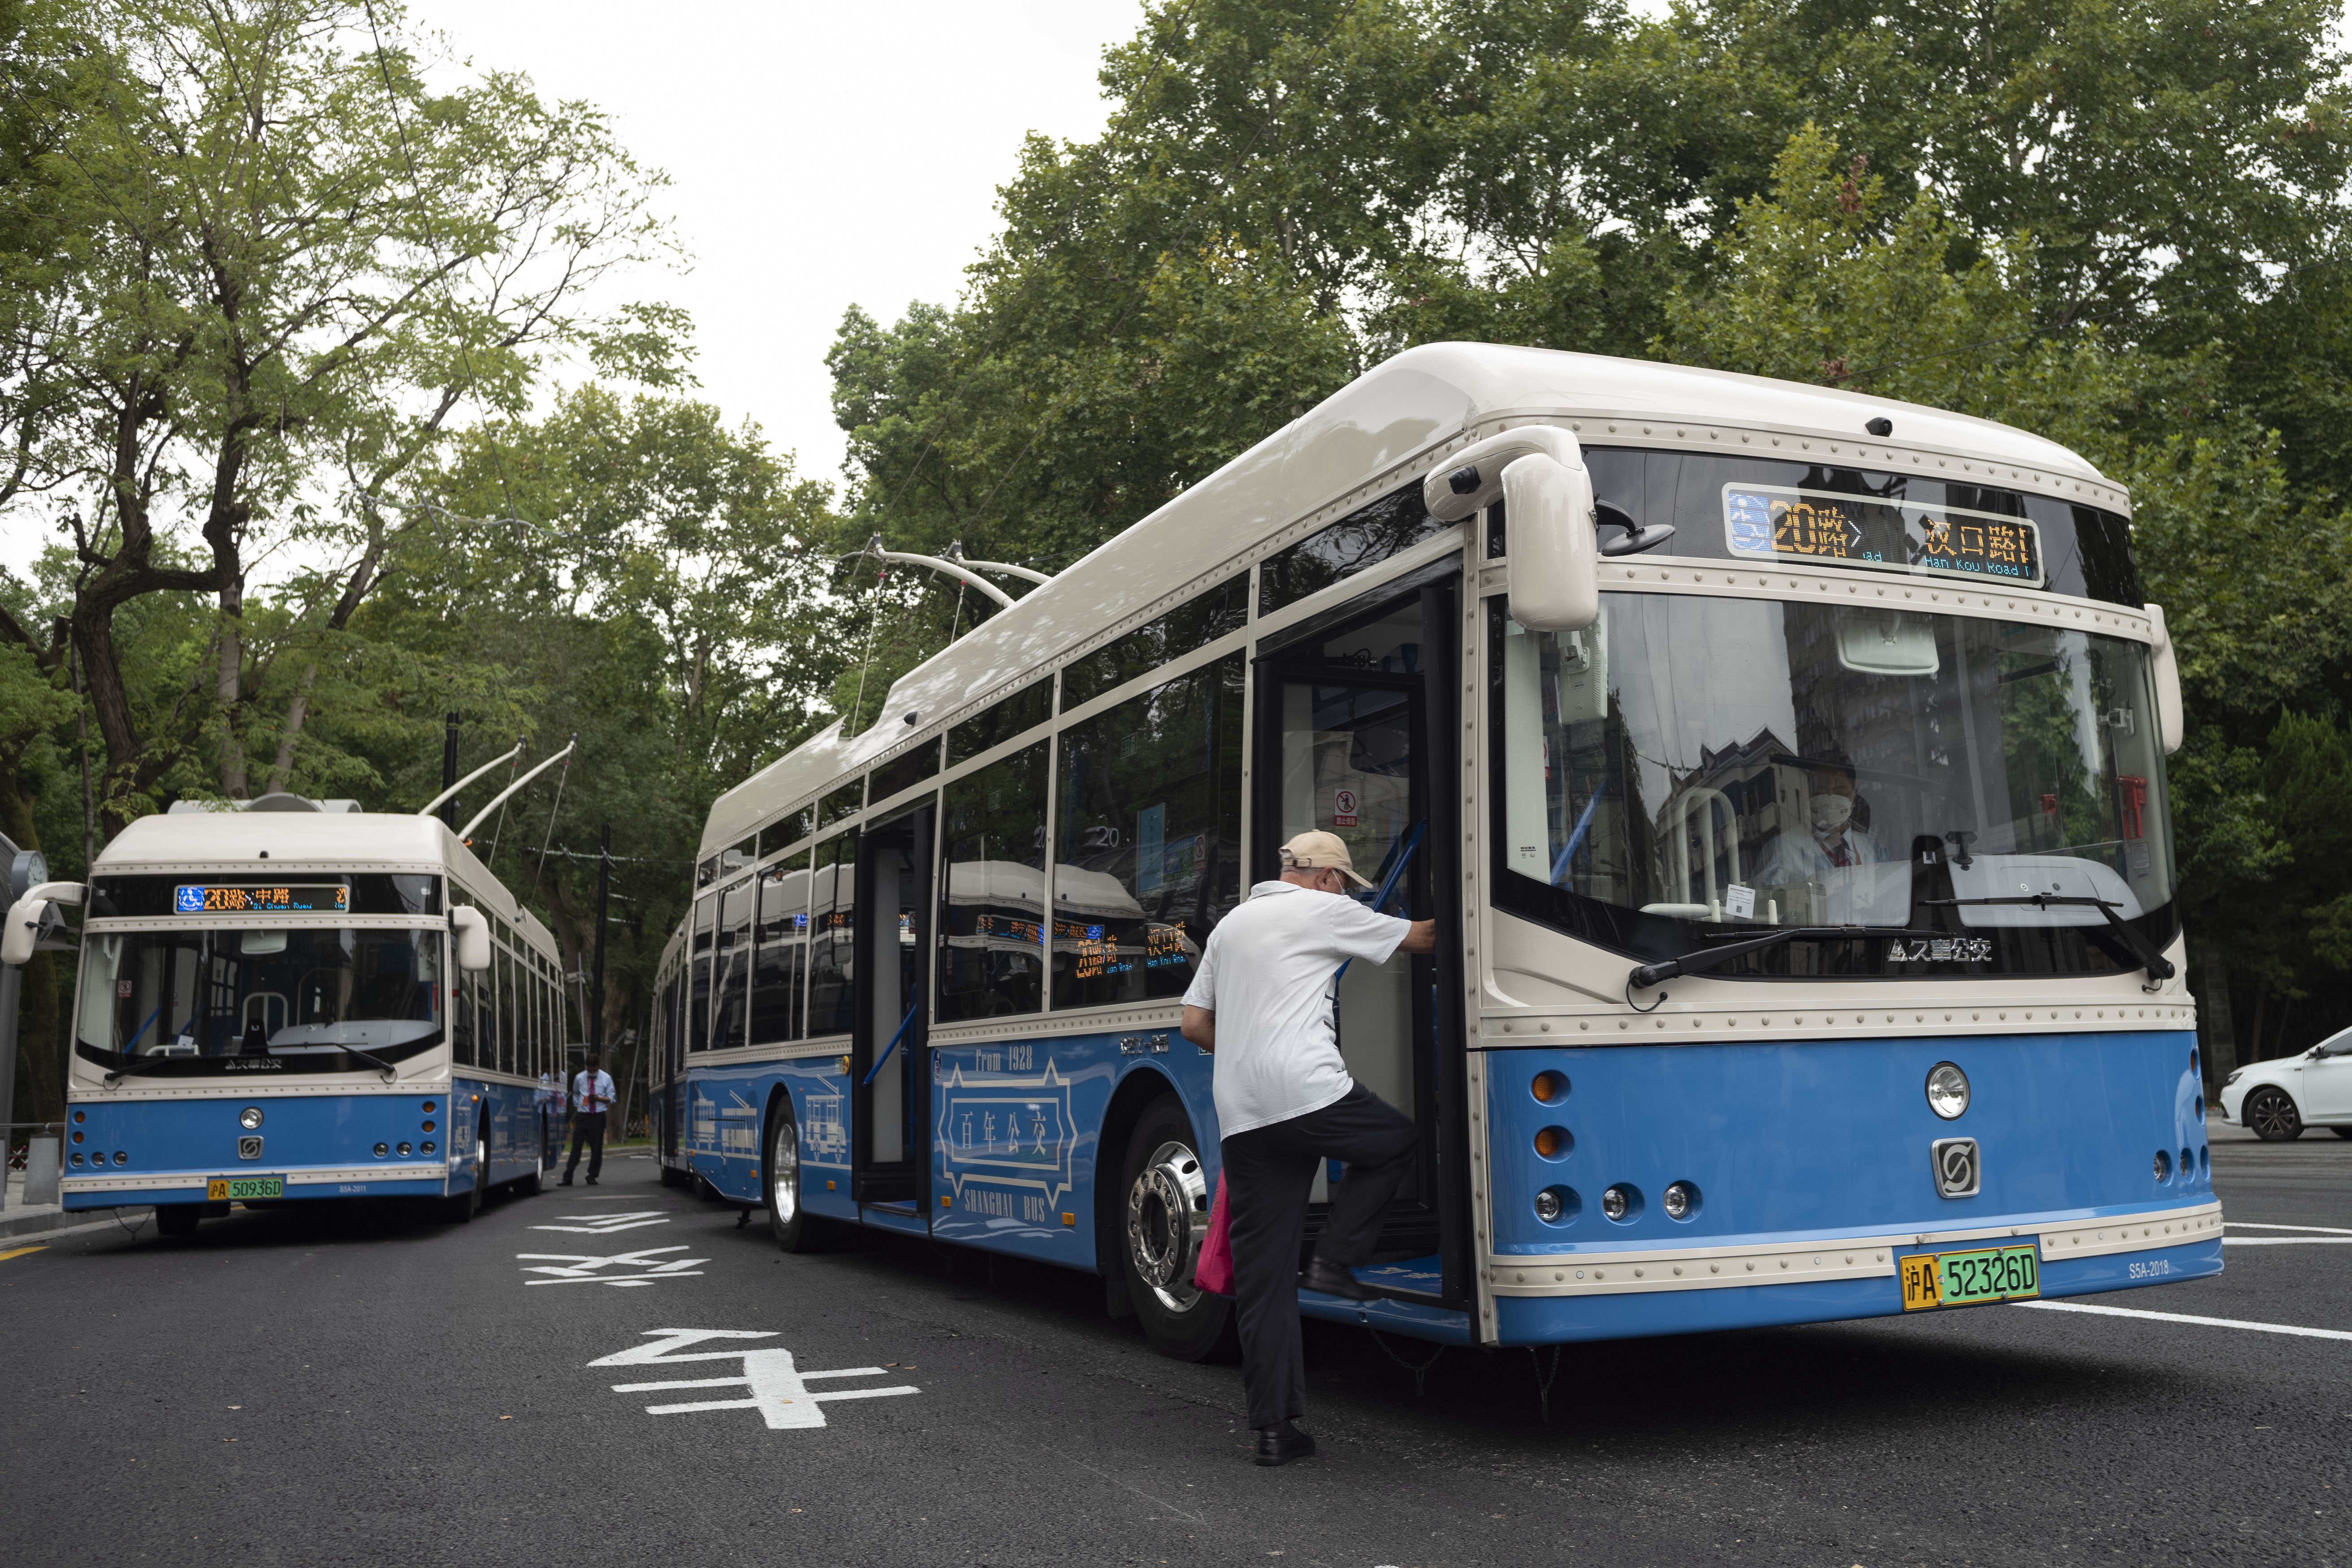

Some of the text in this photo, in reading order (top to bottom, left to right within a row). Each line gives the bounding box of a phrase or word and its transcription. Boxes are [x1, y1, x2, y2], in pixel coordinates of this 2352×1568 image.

[1924, 555, 1949, 569] Han
[1956, 559, 1979, 572] Kou
[1987, 562, 2018, 576] Road
[1096, 826, 1119, 847] 20
[976, 1045, 1032, 1072] From 1928
[961, 1111, 1046, 1156] 百年公交
[232, 1180, 282, 1197] 50936D
[964, 1189, 1044, 1222] SHANGHAI BUS
[1906, 1253, 2035, 1301] 沪A 52326D
[2129, 1260, 2170, 1279] S5A-2018
